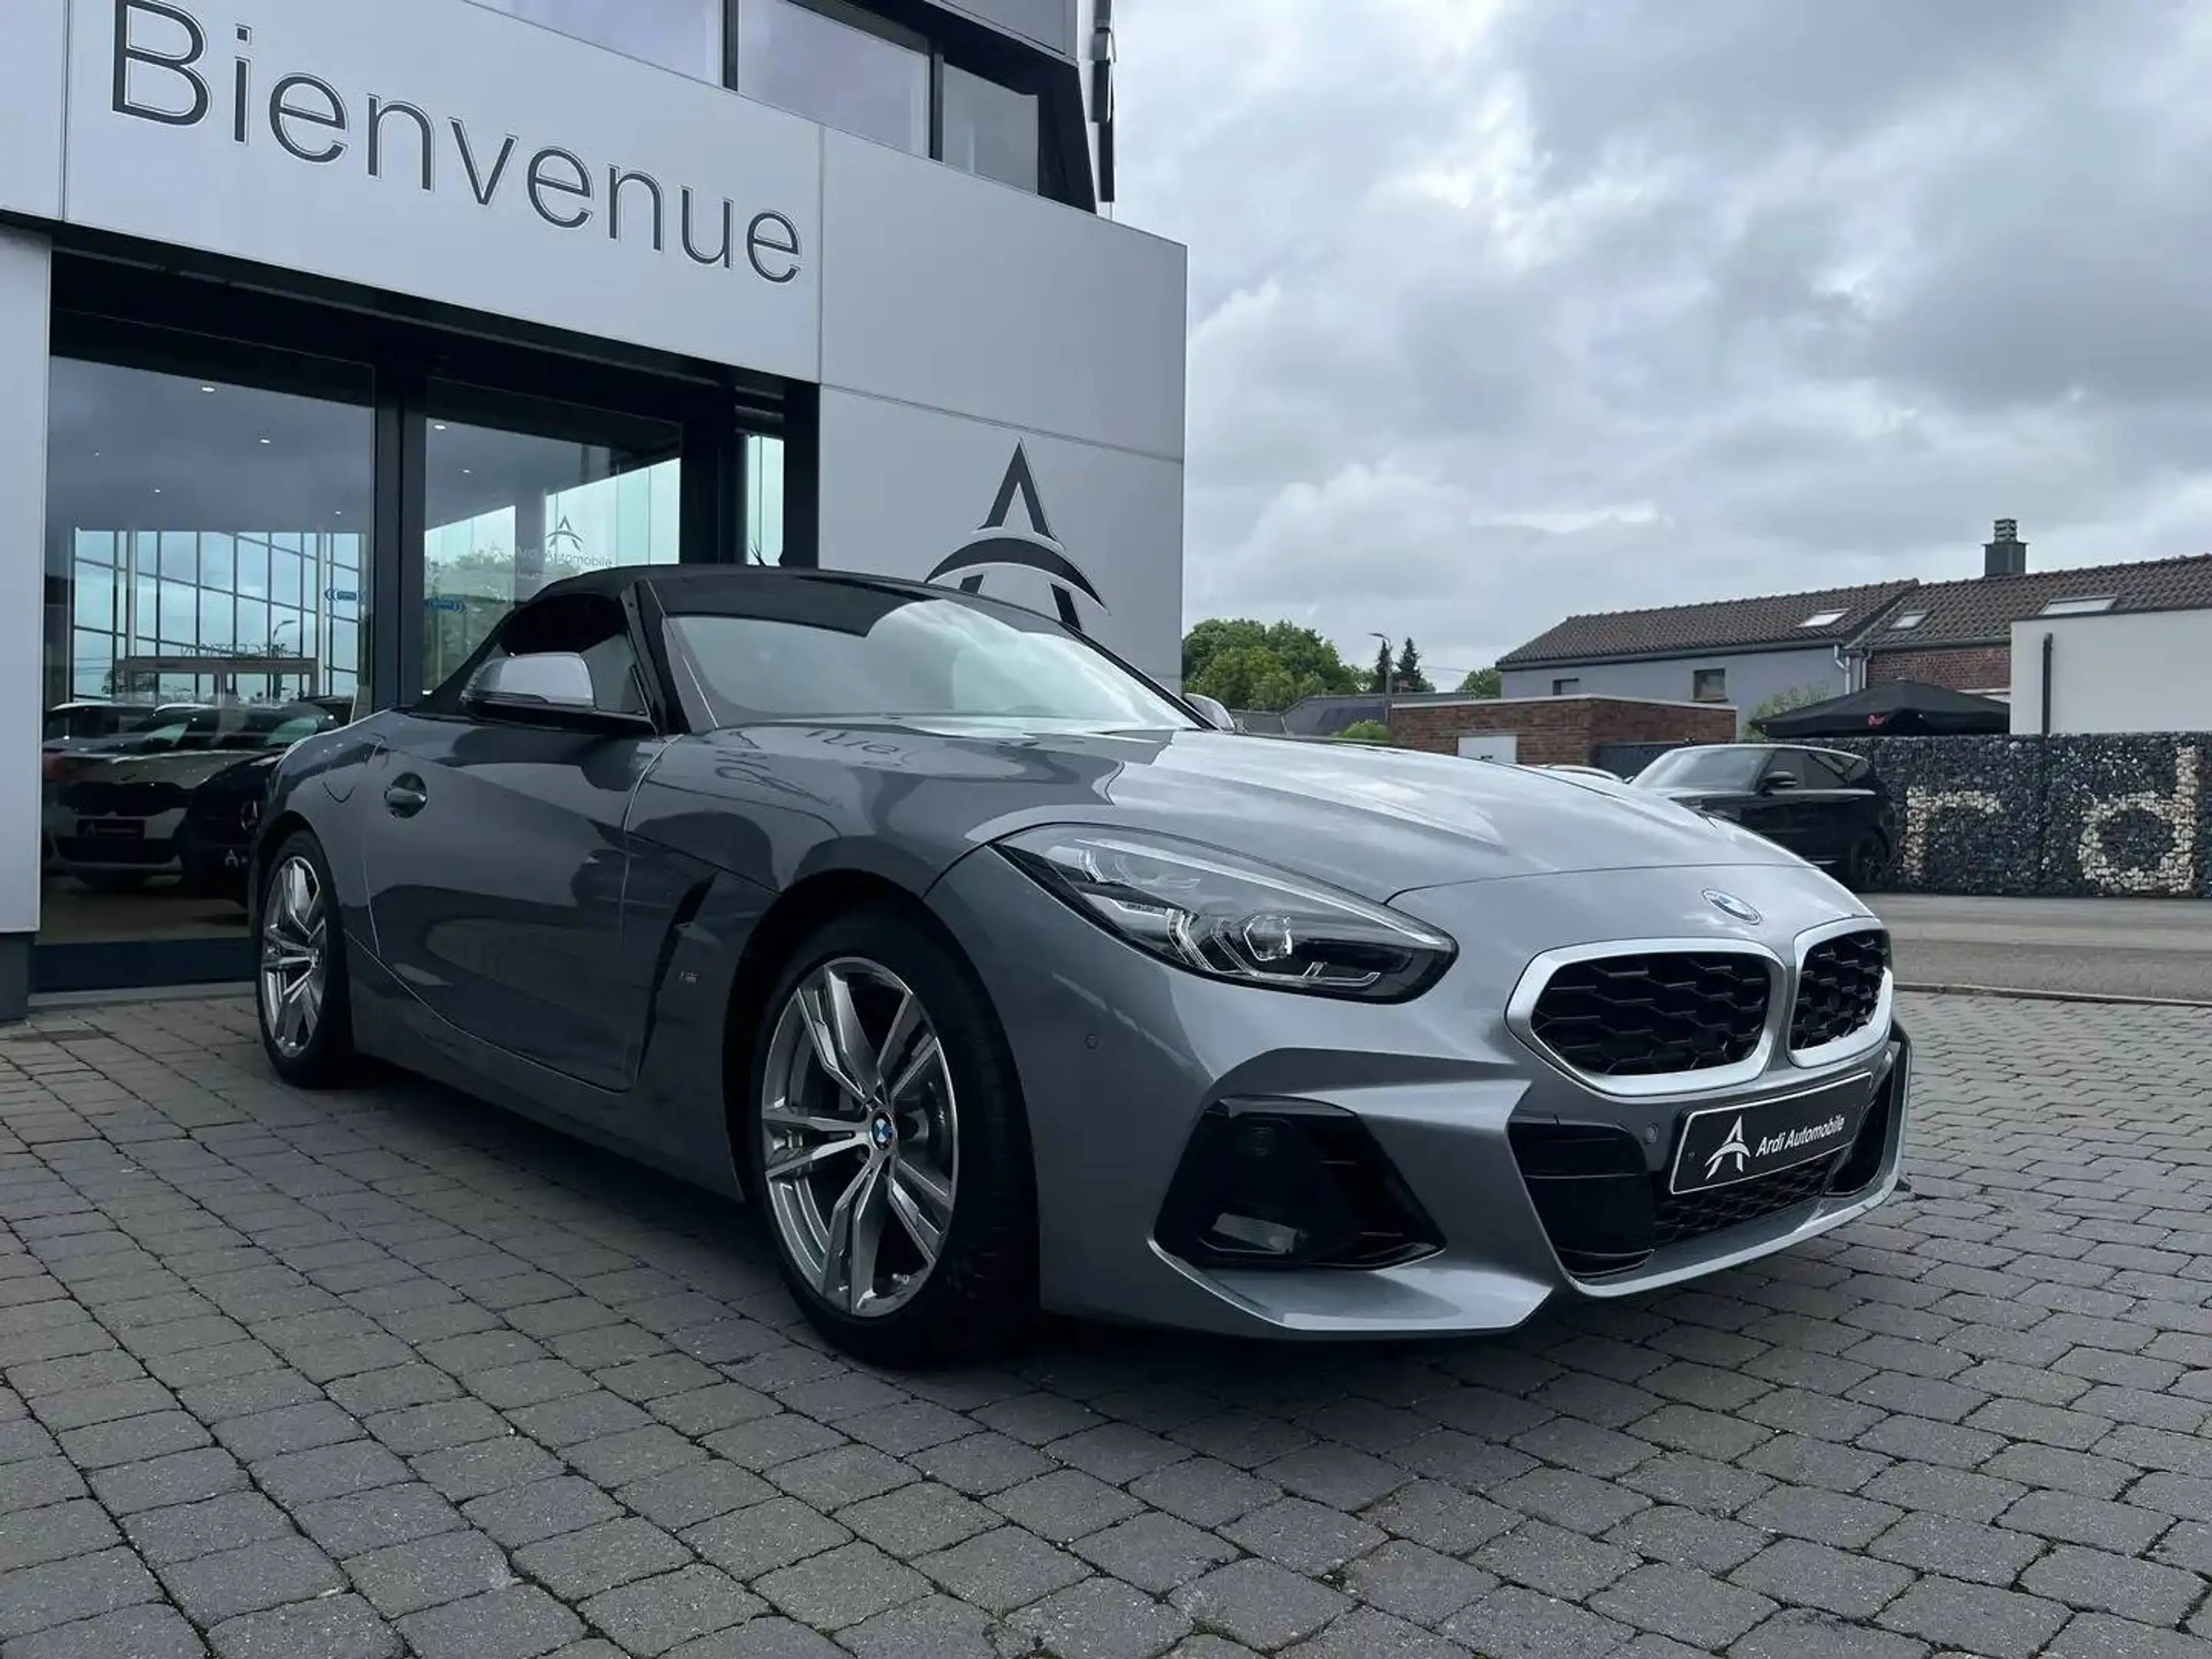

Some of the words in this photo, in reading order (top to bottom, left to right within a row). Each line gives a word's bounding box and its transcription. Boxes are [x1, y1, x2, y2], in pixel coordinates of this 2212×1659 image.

[112, 0, 803, 285] Bienvenue
[1755, 1131, 1786, 1157] Ardi
[1784, 1113, 1845, 1149] Automobile
